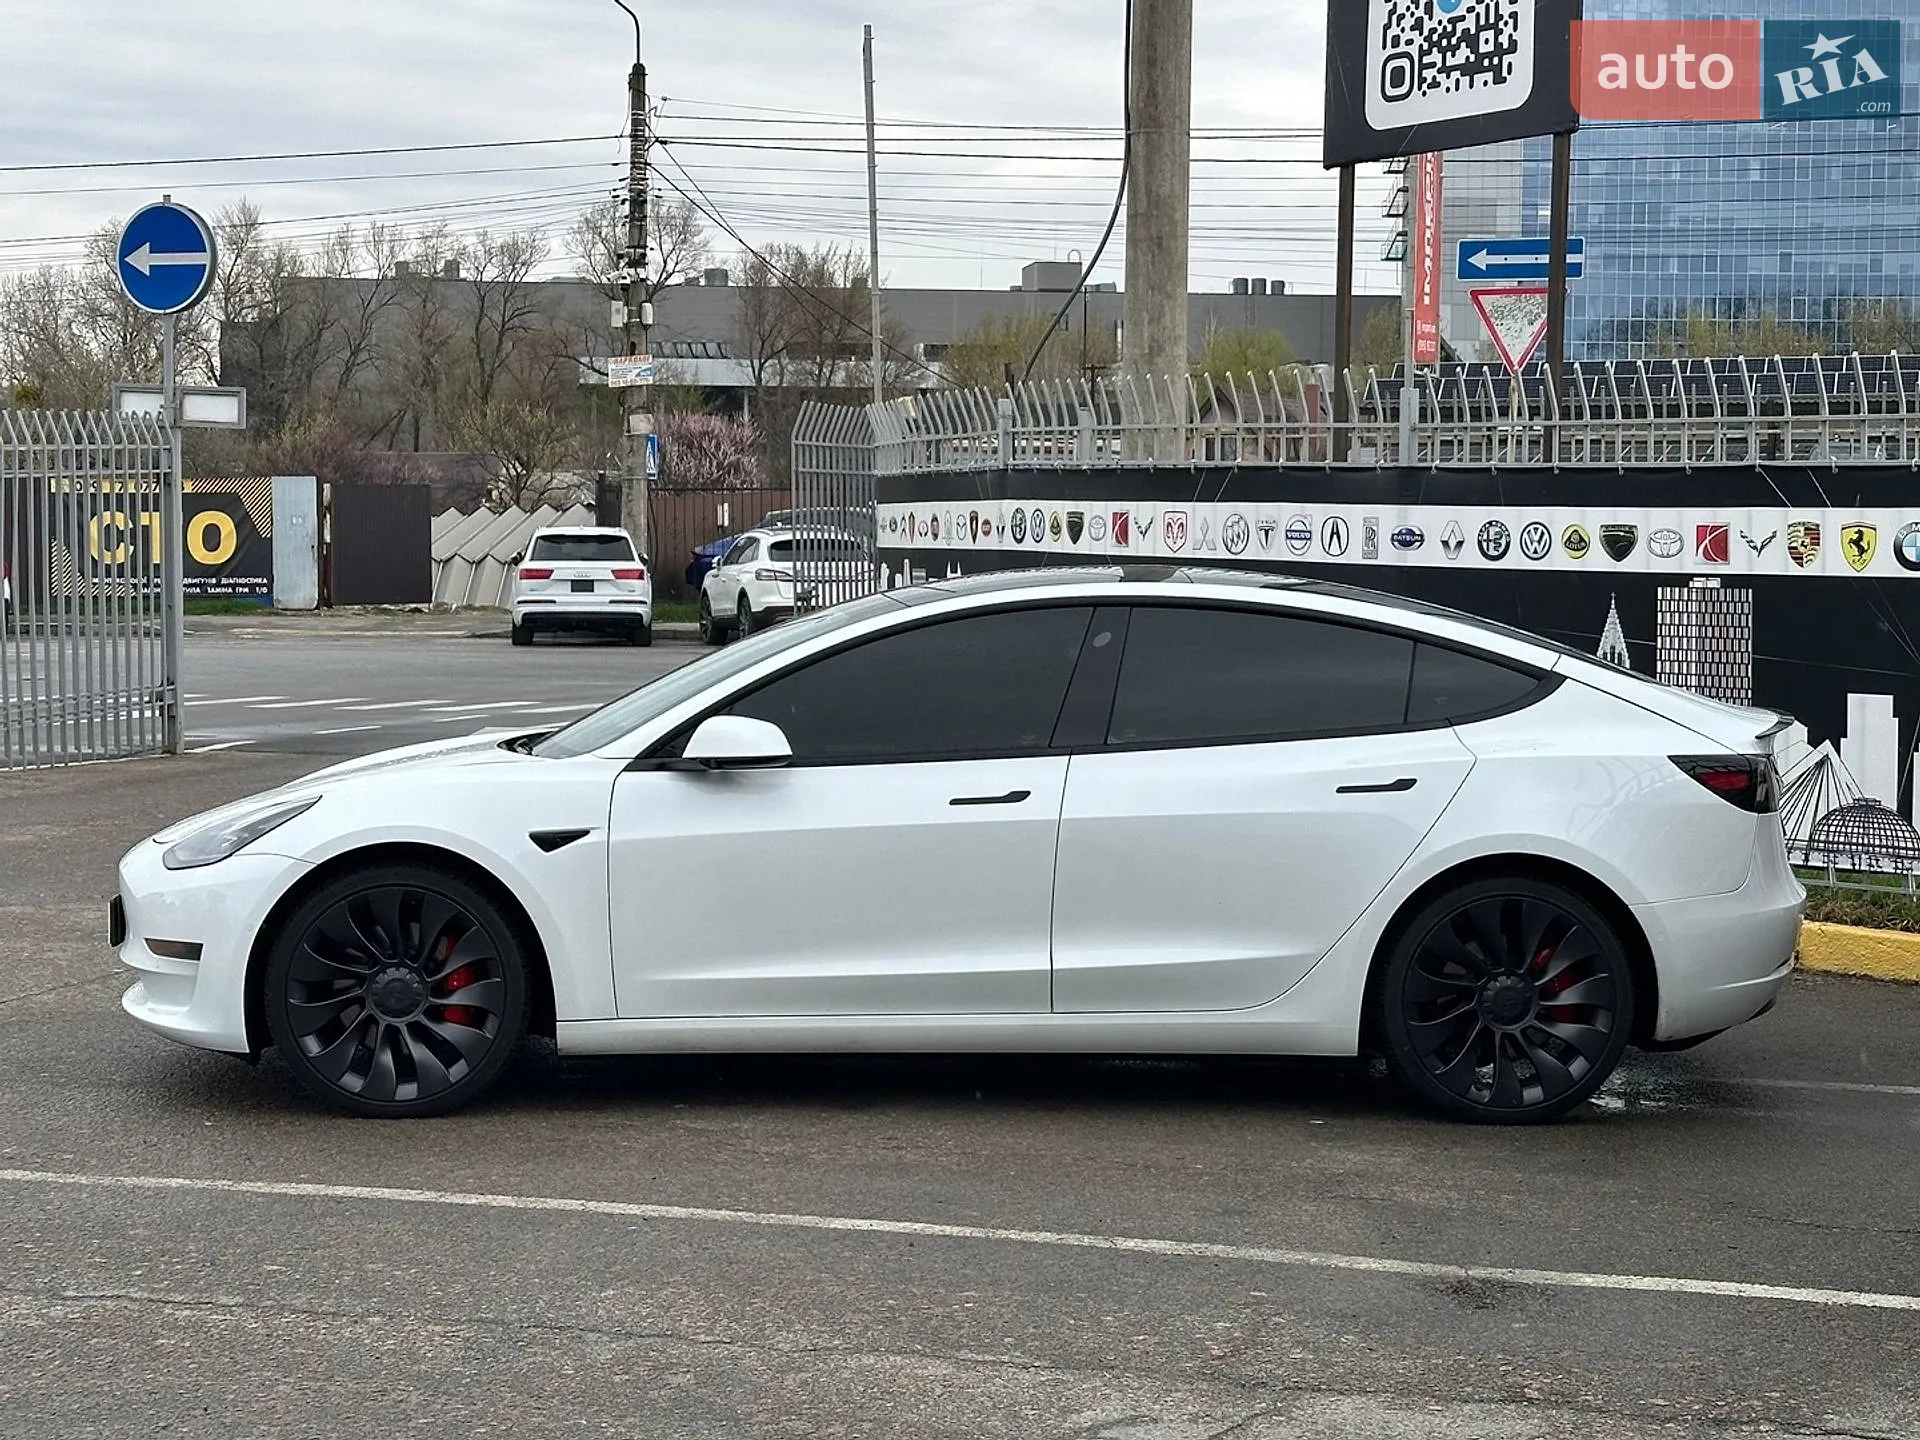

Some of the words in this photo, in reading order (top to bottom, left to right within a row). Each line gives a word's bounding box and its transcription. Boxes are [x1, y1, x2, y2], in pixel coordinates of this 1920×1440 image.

[1286, 531, 1311, 540] VOLVO
[1393, 534, 1421, 542] DATSUN
[1565, 541, 1588, 550] LOTUS
